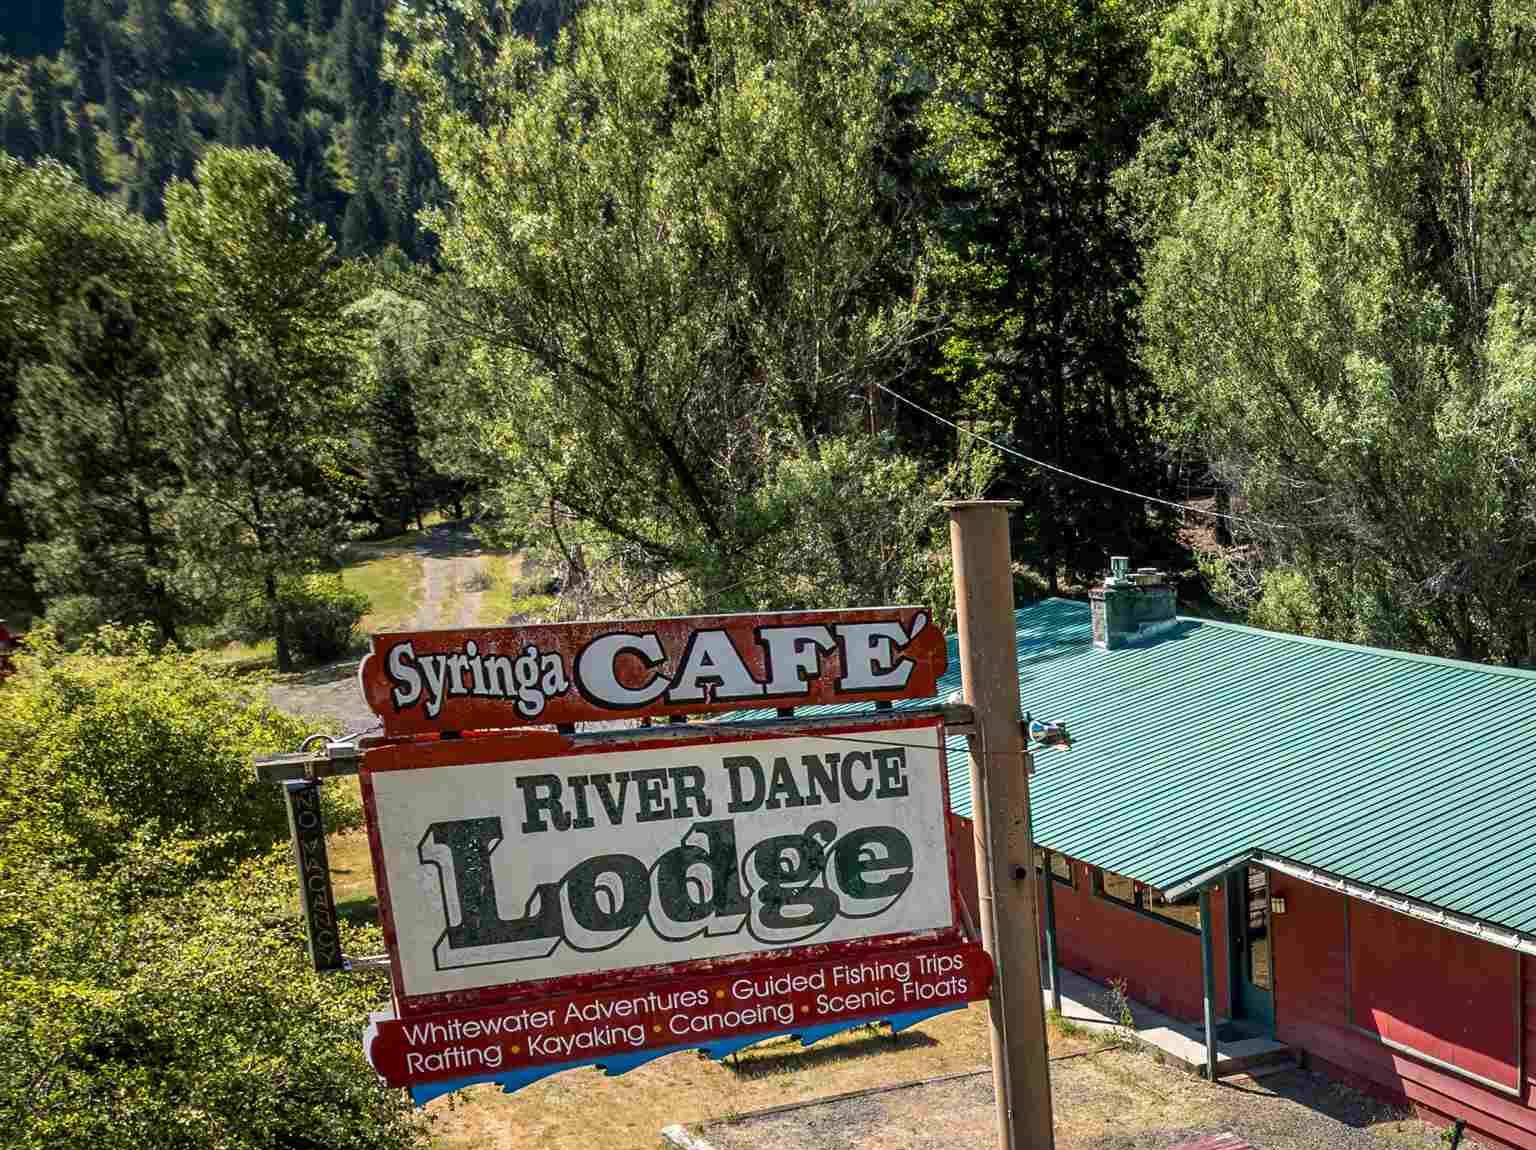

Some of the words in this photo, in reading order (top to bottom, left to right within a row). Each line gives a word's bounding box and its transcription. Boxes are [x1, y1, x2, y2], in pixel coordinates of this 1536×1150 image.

[388, 640, 568, 717] Syringa
[515, 765, 712, 834] RIVER
[722, 747, 909, 813] DANCE
[417, 819, 914, 971] Lodge
[402, 1006, 557, 1047] Whitewater
[563, 988, 710, 1024] Adventures
[732, 971, 826, 1003] Guided
[833, 960, 912, 990] Fishing
[916, 953, 964, 979] Trips
[406, 1041, 503, 1075] Rafting
[527, 1022, 646, 1058] Kayaking
[669, 1003, 795, 1036] Canoeing
[816, 988, 896, 1015] Scenic
[902, 976, 968, 1001] Floats
